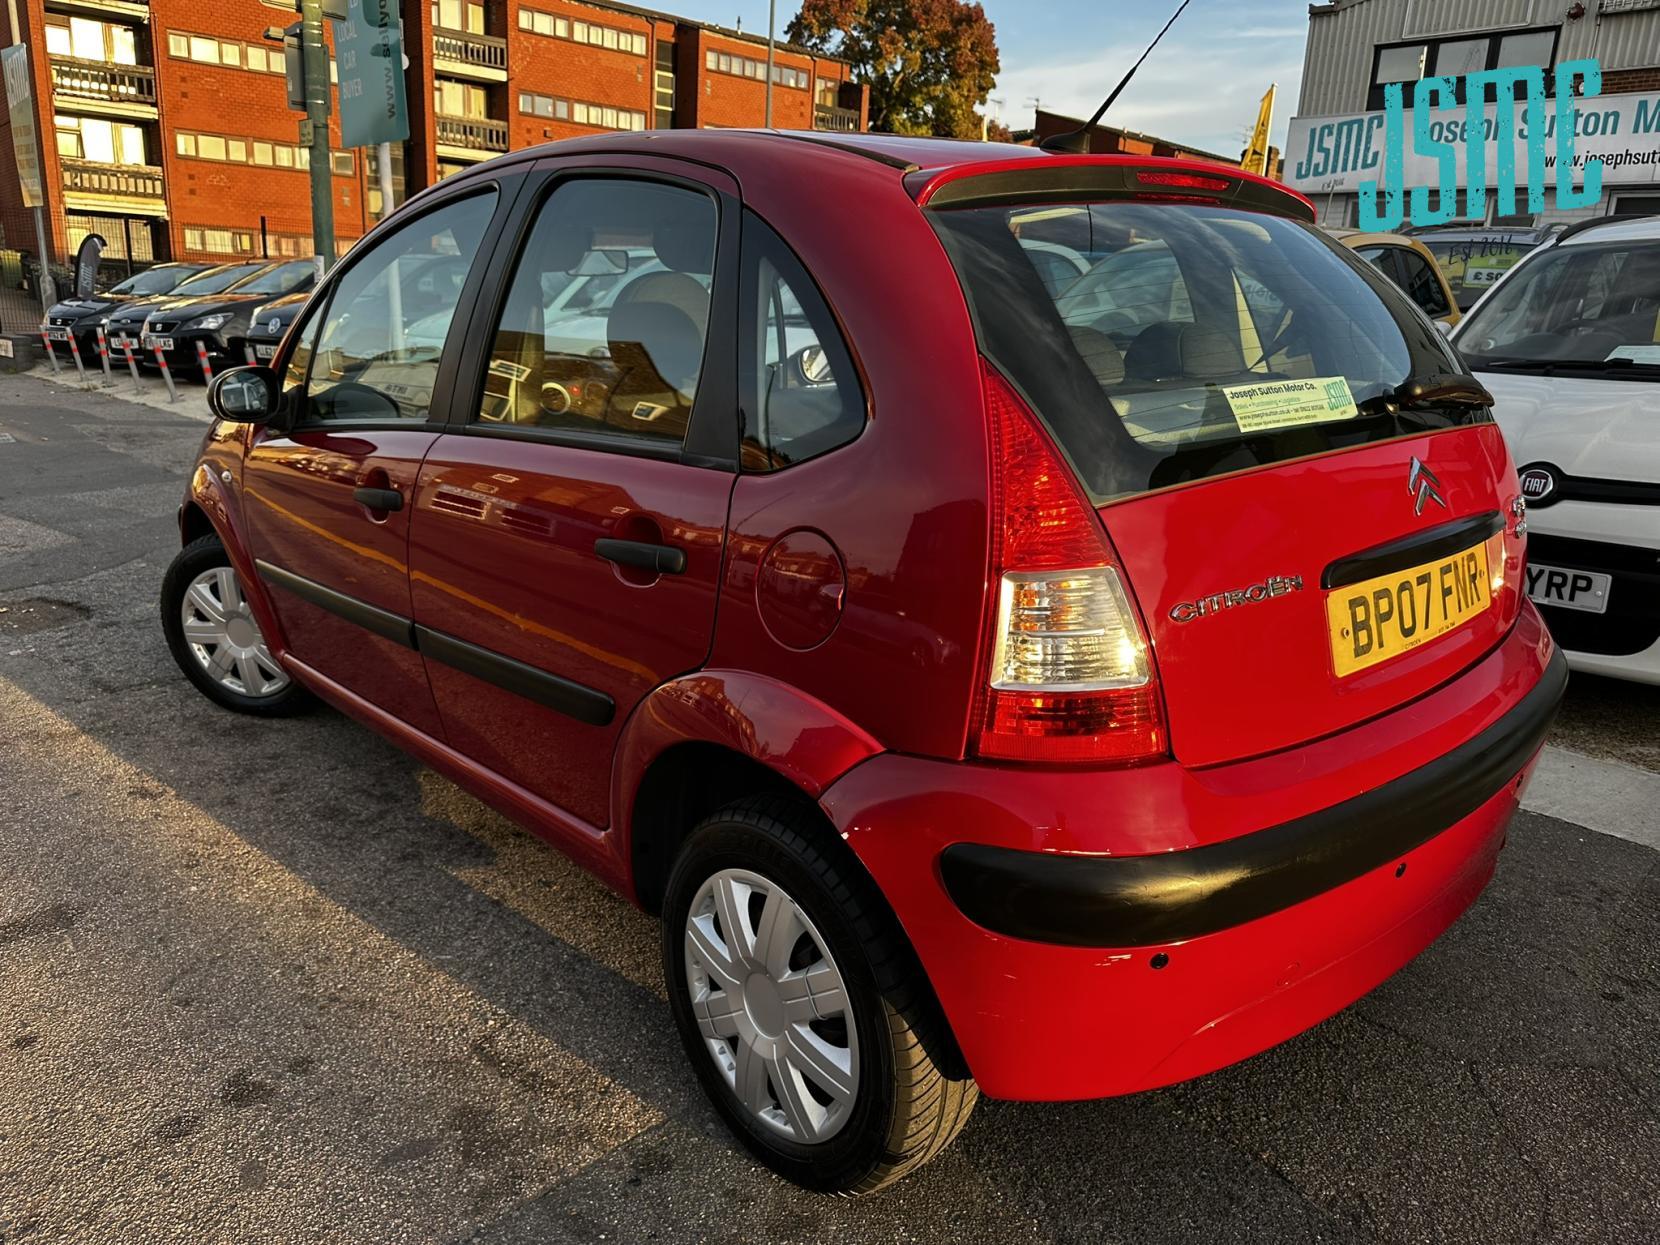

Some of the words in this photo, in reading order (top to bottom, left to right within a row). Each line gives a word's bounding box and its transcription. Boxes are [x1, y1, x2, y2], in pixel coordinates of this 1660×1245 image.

[337, 20, 358, 42] LOCAL
[343, 49, 356, 71] CAR
[342, 78, 363, 99] BUYER
[1295, 114, 1384, 180] JSMC
[1230, 388, 1259, 400] Joseph
[1260, 385, 1284, 396] Sutton
[1284, 383, 1305, 392] Motor
[1305, 382, 1317, 391] Co.
[1323, 380, 1352, 411] JSMC
[1523, 477, 1547, 493] FIAT
[1526, 567, 1593, 602] YRP
[1348, 571, 1432, 658] BP07
[1439, 552, 1481, 620] FNR
